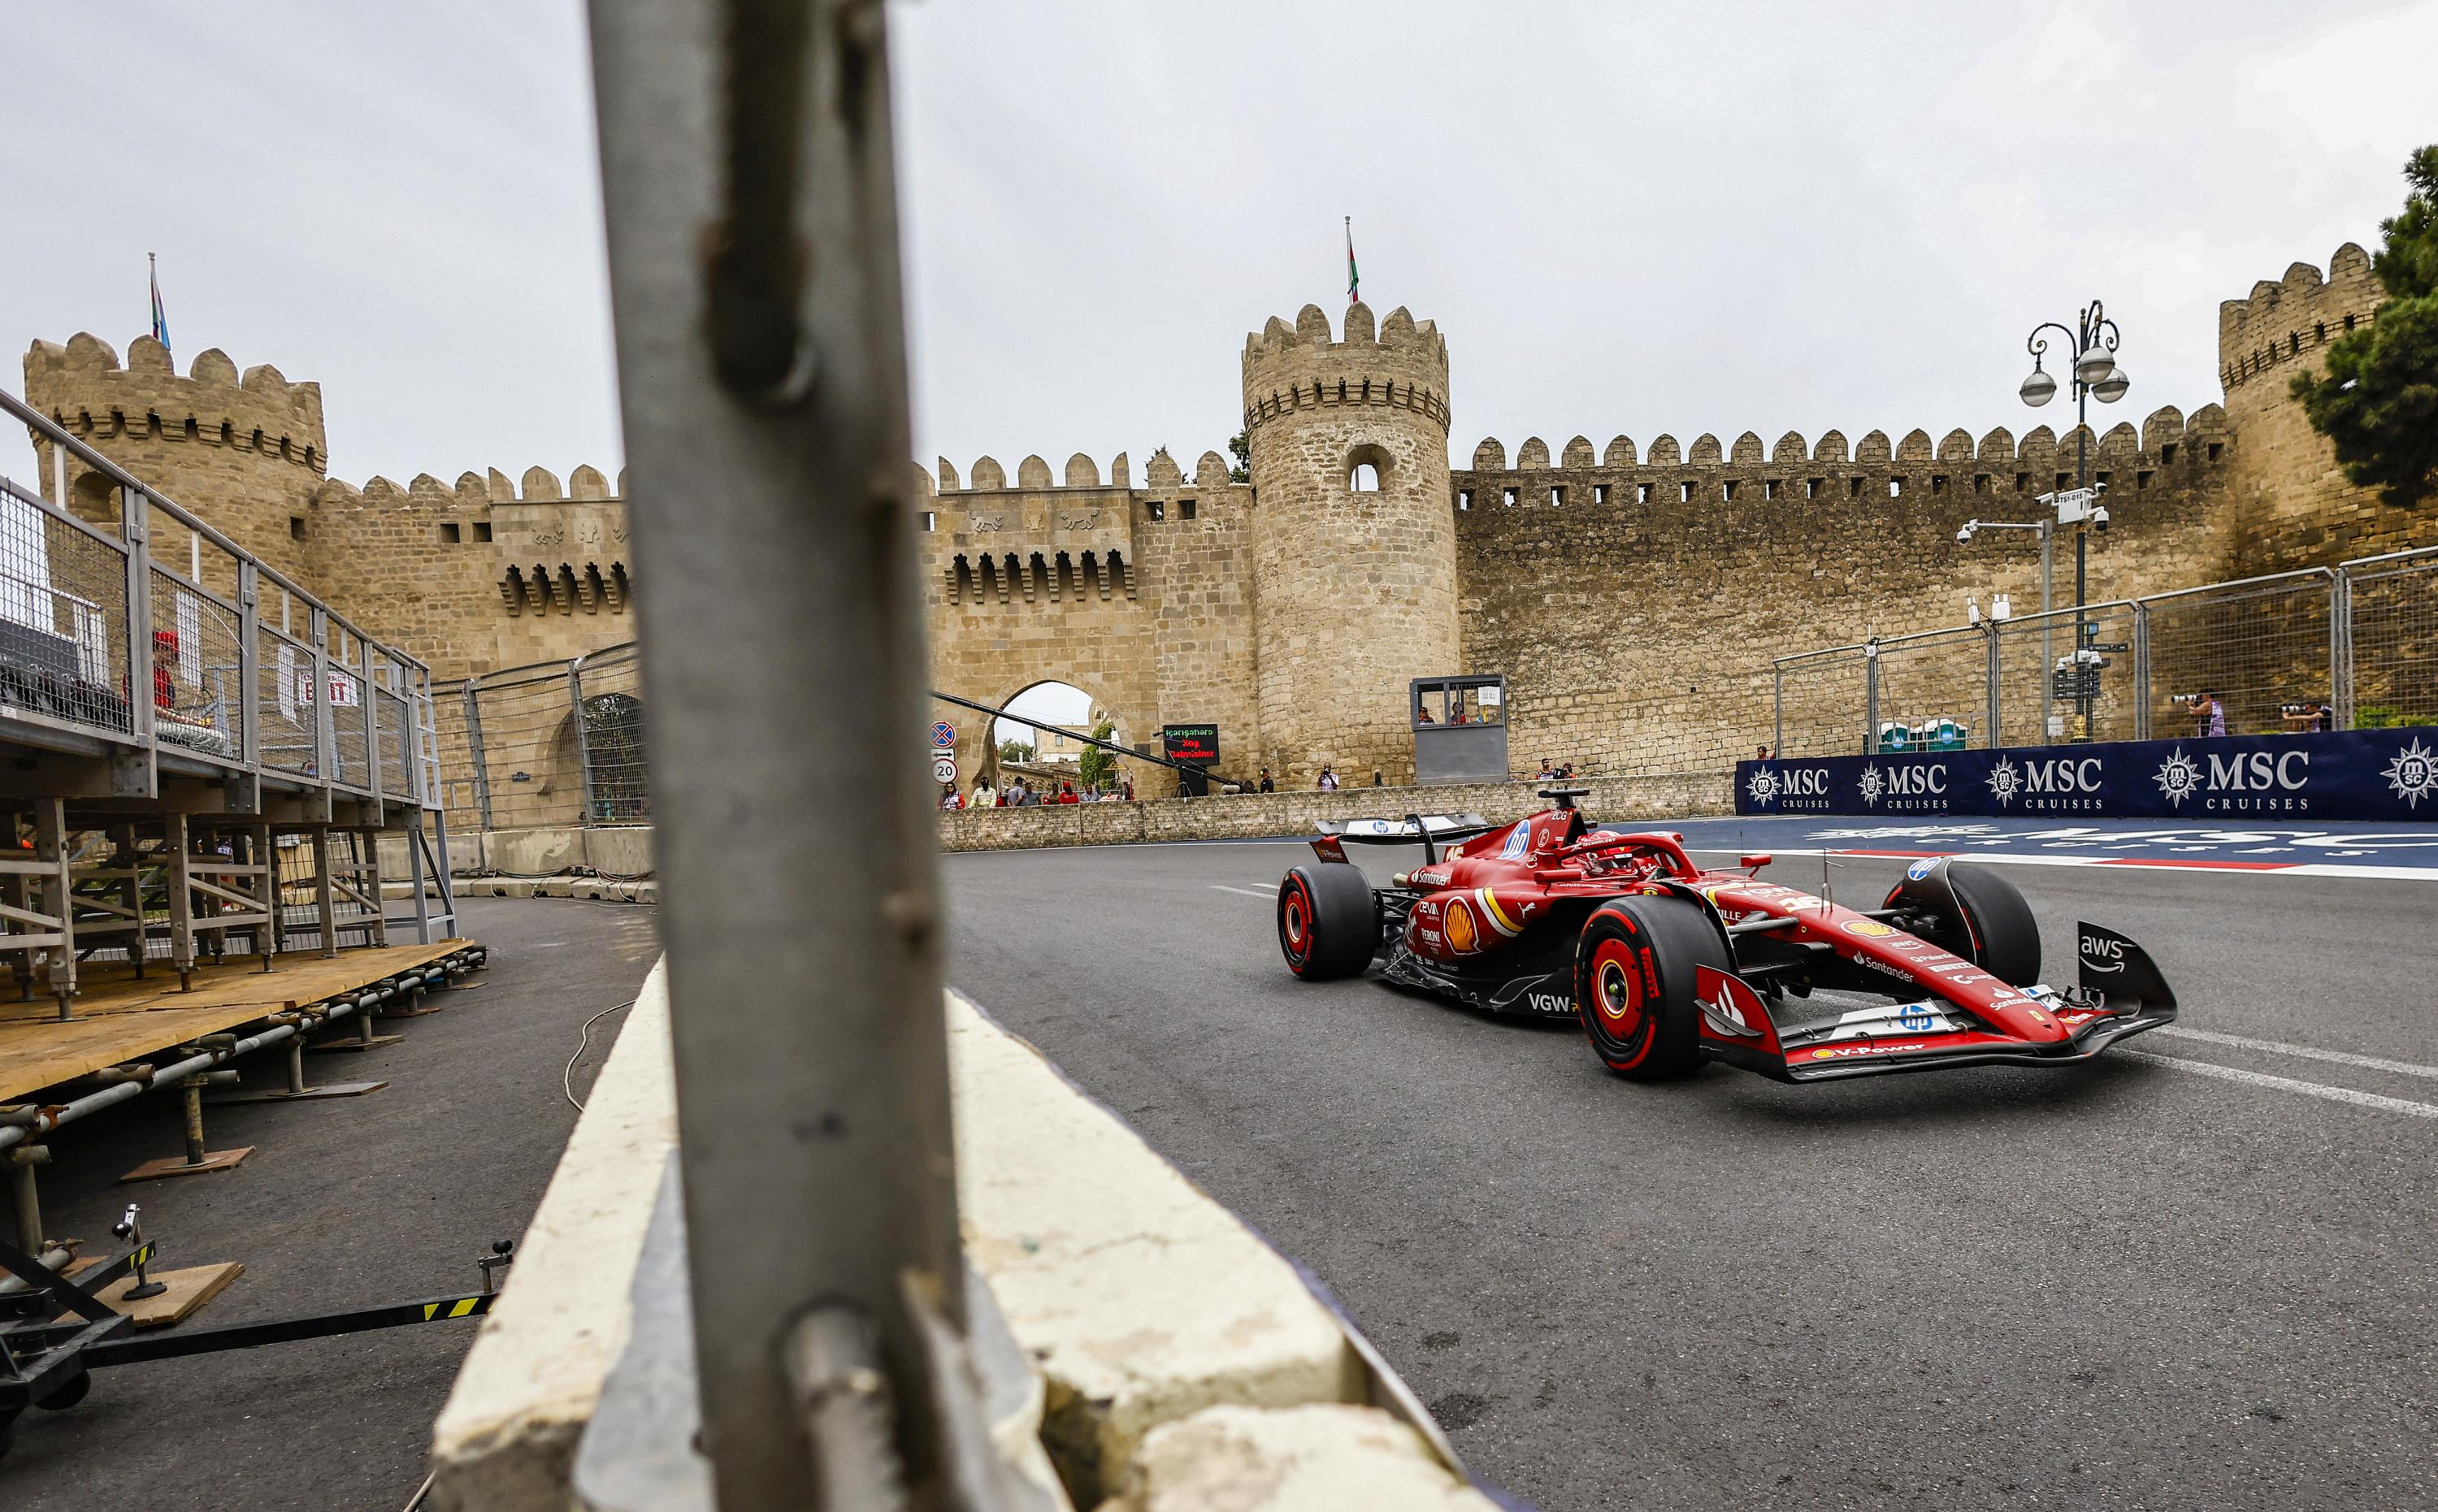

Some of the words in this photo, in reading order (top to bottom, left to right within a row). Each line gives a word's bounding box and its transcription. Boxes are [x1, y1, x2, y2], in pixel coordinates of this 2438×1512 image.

[306, 682, 345, 701] EIT
[937, 766, 952, 777] 20
[1887, 764, 1946, 795] MSC
[2024, 758, 2102, 793] MSC
[2206, 751, 2309, 791] MSC
[1782, 769, 1828, 795] MSC
[1782, 799, 1829, 808] CRUISES
[1887, 799, 1948, 809] CRUISES
[2025, 799, 2102, 809] CRUISES
[2206, 799, 2308, 810] CRUISES
[1373, 821, 1389, 834] hp
[1500, 820, 1530, 859] hp
[1418, 871, 1450, 886] Santander
[1908, 857, 1941, 881] hp
[1778, 895, 1829, 913] 16
[1421, 928, 1441, 942] PERONI
[2081, 935, 2119, 959] aws
[1866, 956, 1914, 983] Santander
[1529, 993, 1569, 1012] VGW
[1900, 1005, 1933, 1031] hp
[1834, 1043, 1925, 1056] V-Power
